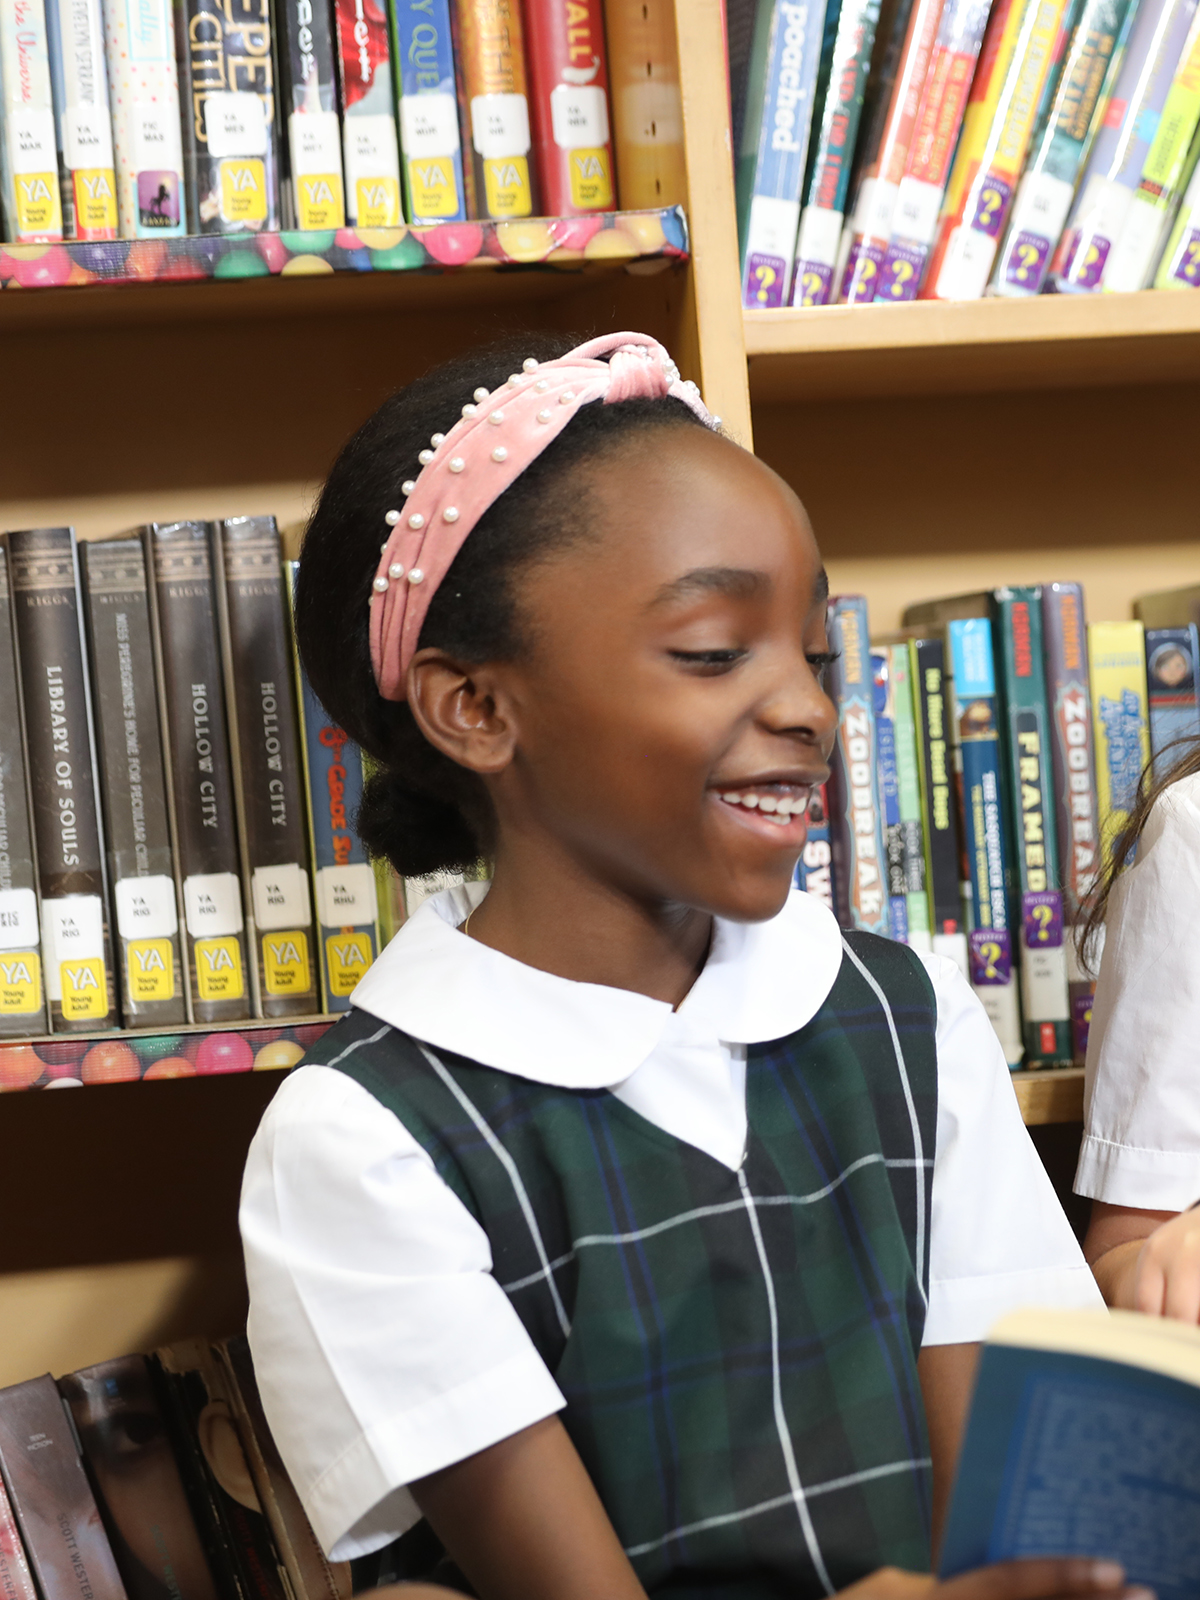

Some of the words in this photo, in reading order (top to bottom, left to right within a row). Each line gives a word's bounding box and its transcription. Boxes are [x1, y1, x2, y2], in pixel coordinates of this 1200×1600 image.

[563, 0, 592, 62] ALL
[772, 1, 808, 151] poached
[416, 167, 447, 188] YA
[491, 166, 522, 188] YA
[575, 157, 604, 179] YA
[20, 179, 52, 201] YA
[81, 176, 112, 198] YA
[226, 169, 258, 192] YA
[304, 181, 335, 203] YA
[360, 185, 389, 208] YA
[115, 612, 129, 642] MISS
[925, 668, 941, 693] No
[46, 666, 70, 756] LIBRARY
[927, 694, 944, 739] More
[124, 720, 139, 755] HOME
[191, 684, 214, 773] HOLLOW
[260, 682, 283, 772] HOLLOW
[127, 757, 141, 782] FOR
[930, 740, 948, 784] Dead
[55, 761, 73, 790] OF
[199, 780, 219, 828] CITY
[268, 778, 288, 827] CITY
[328, 765, 348, 830] GRADE
[933, 785, 950, 830] Dogs
[846, 712, 883, 914] ZOOBREAK
[1017, 731, 1047, 892] FRAMED
[59, 797, 80, 867] SOULS
[132, 897, 146, 906] YA
[198, 894, 212, 903] YA
[266, 885, 281, 894] YA
[268, 896, 286, 906] RIG
[332, 885, 347, 894] YA
[133, 907, 151, 917] RIG
[199, 904, 217, 914] RIG
[60, 918, 75, 927] YA
[62, 929, 80, 938] RIG
[134, 948, 166, 972] YA
[202, 947, 234, 971] YA
[270, 942, 301, 965] YA
[333, 944, 366, 967] YA
[0, 962, 32, 984] YA
[67, 968, 99, 990] YA
[56, 1513, 75, 1548] SCOTT
[71, 1551, 95, 1600] WESTER
